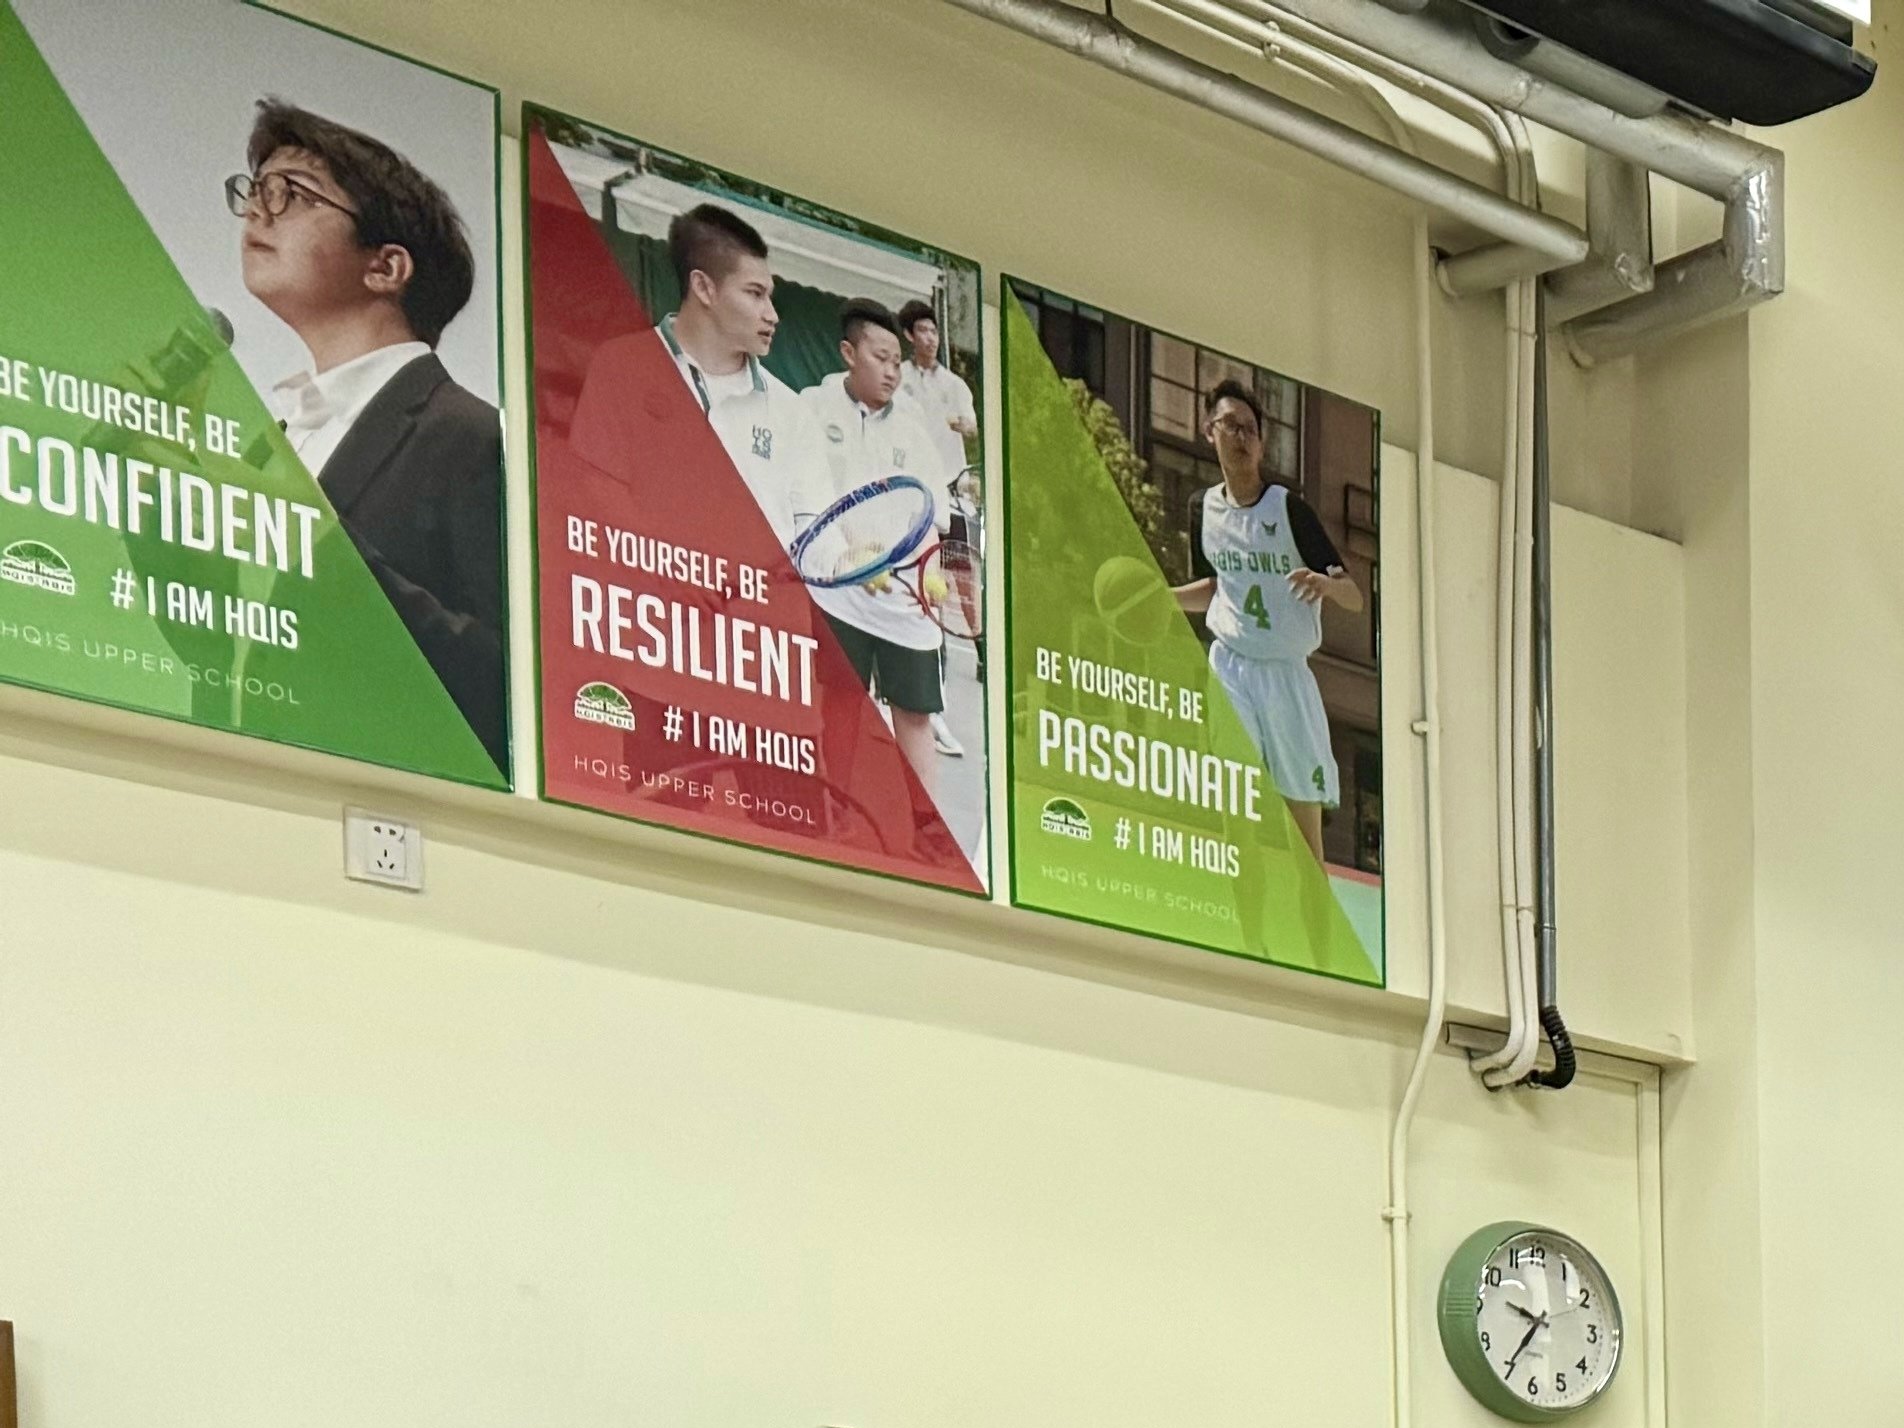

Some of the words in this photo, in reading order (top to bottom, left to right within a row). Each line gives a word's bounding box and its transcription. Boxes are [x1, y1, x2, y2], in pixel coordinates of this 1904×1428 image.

[38, 366, 197, 452] YOURSELF,
[205, 413, 242, 459] BE
[0, 425, 321, 579] CONFIDENT
[567, 515, 598, 558] BE
[605, 525, 732, 600] YOURSELF,
[739, 563, 769, 604] BE
[1247, 552, 1291, 575] OWLS
[147, 576, 156, 616] I
[167, 582, 214, 631] AM
[225, 595, 298, 650] HQIS
[1242, 584, 1272, 630] 4
[1, 621, 70, 652] HQIS
[84, 639, 174, 676] UPPER
[187, 663, 300, 705] SCHOOL
[571, 573, 819, 707] RESILIENT
[1036, 646, 1062, 686] BE
[1068, 656, 1173, 720] YOURSELF,
[1179, 686, 1203, 724] BE
[692, 711, 701, 748] I
[709, 716, 747, 760] AM
[755, 726, 816, 776] HQIS
[1038, 708, 1262, 822] PASSIONATE
[574, 755, 632, 781] HQIS
[641, 771, 715, 801] UPPER
[724, 789, 817, 826] SCHOOL
[1312, 765, 1326, 792] 4
[1138, 823, 1146, 855] I
[1153, 827, 1183, 865] AM
[1190, 834, 1240, 878] HQIS
[1041, 865, 1088, 888] HQIS
[1096, 875, 1157, 901] UPPER
[1163, 886, 1240, 924] SCHOOL
[1484, 1266, 1501, 1288] 10
[1509, 1248, 1520, 1269] 11
[1561, 1263, 1567, 1281] 1
[1579, 1288, 1590, 1309] 2
[1586, 1324, 1598, 1344] 3
[1527, 1376, 1539, 1396] 6
[1555, 1373, 1567, 1392] 5
[1575, 1355, 1588, 1375] 4
